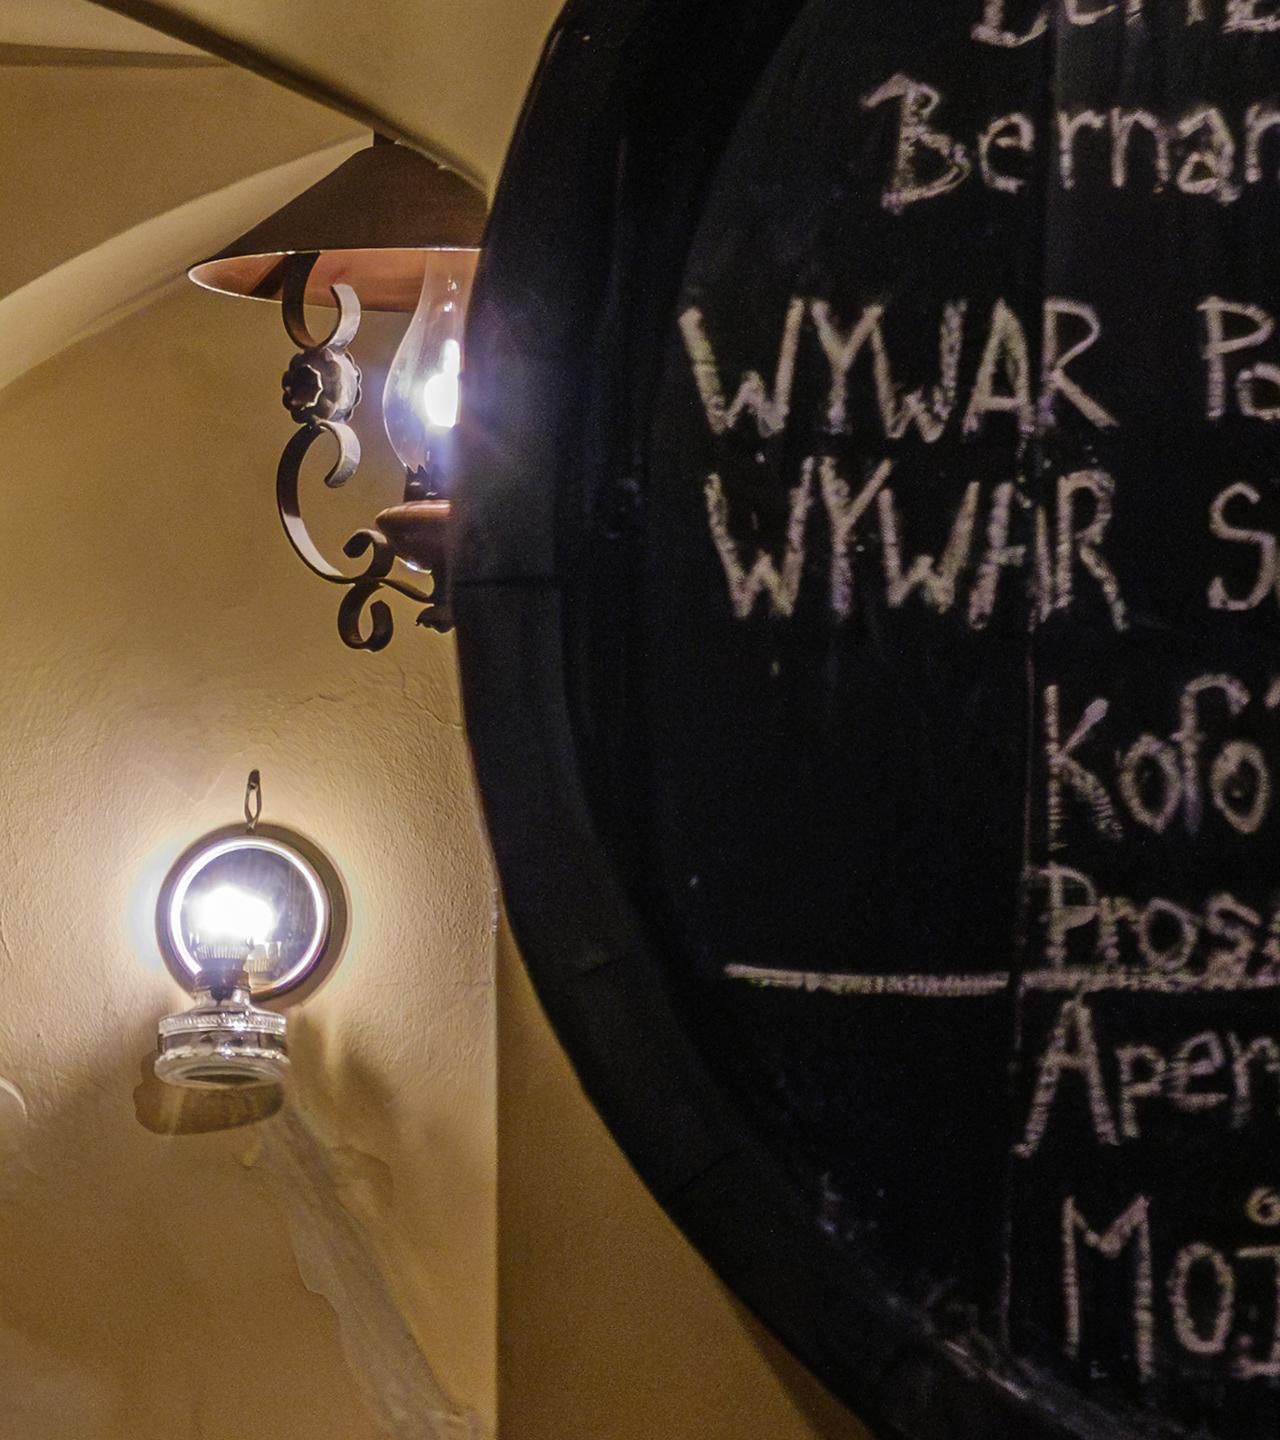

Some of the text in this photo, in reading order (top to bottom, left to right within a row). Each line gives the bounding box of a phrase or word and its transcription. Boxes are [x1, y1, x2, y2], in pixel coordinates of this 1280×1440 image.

[678, 297, 1120, 443] WYWAR
[703, 456, 1130, 632] WYWAR
[1044, 672, 1280, 851] Kofo
